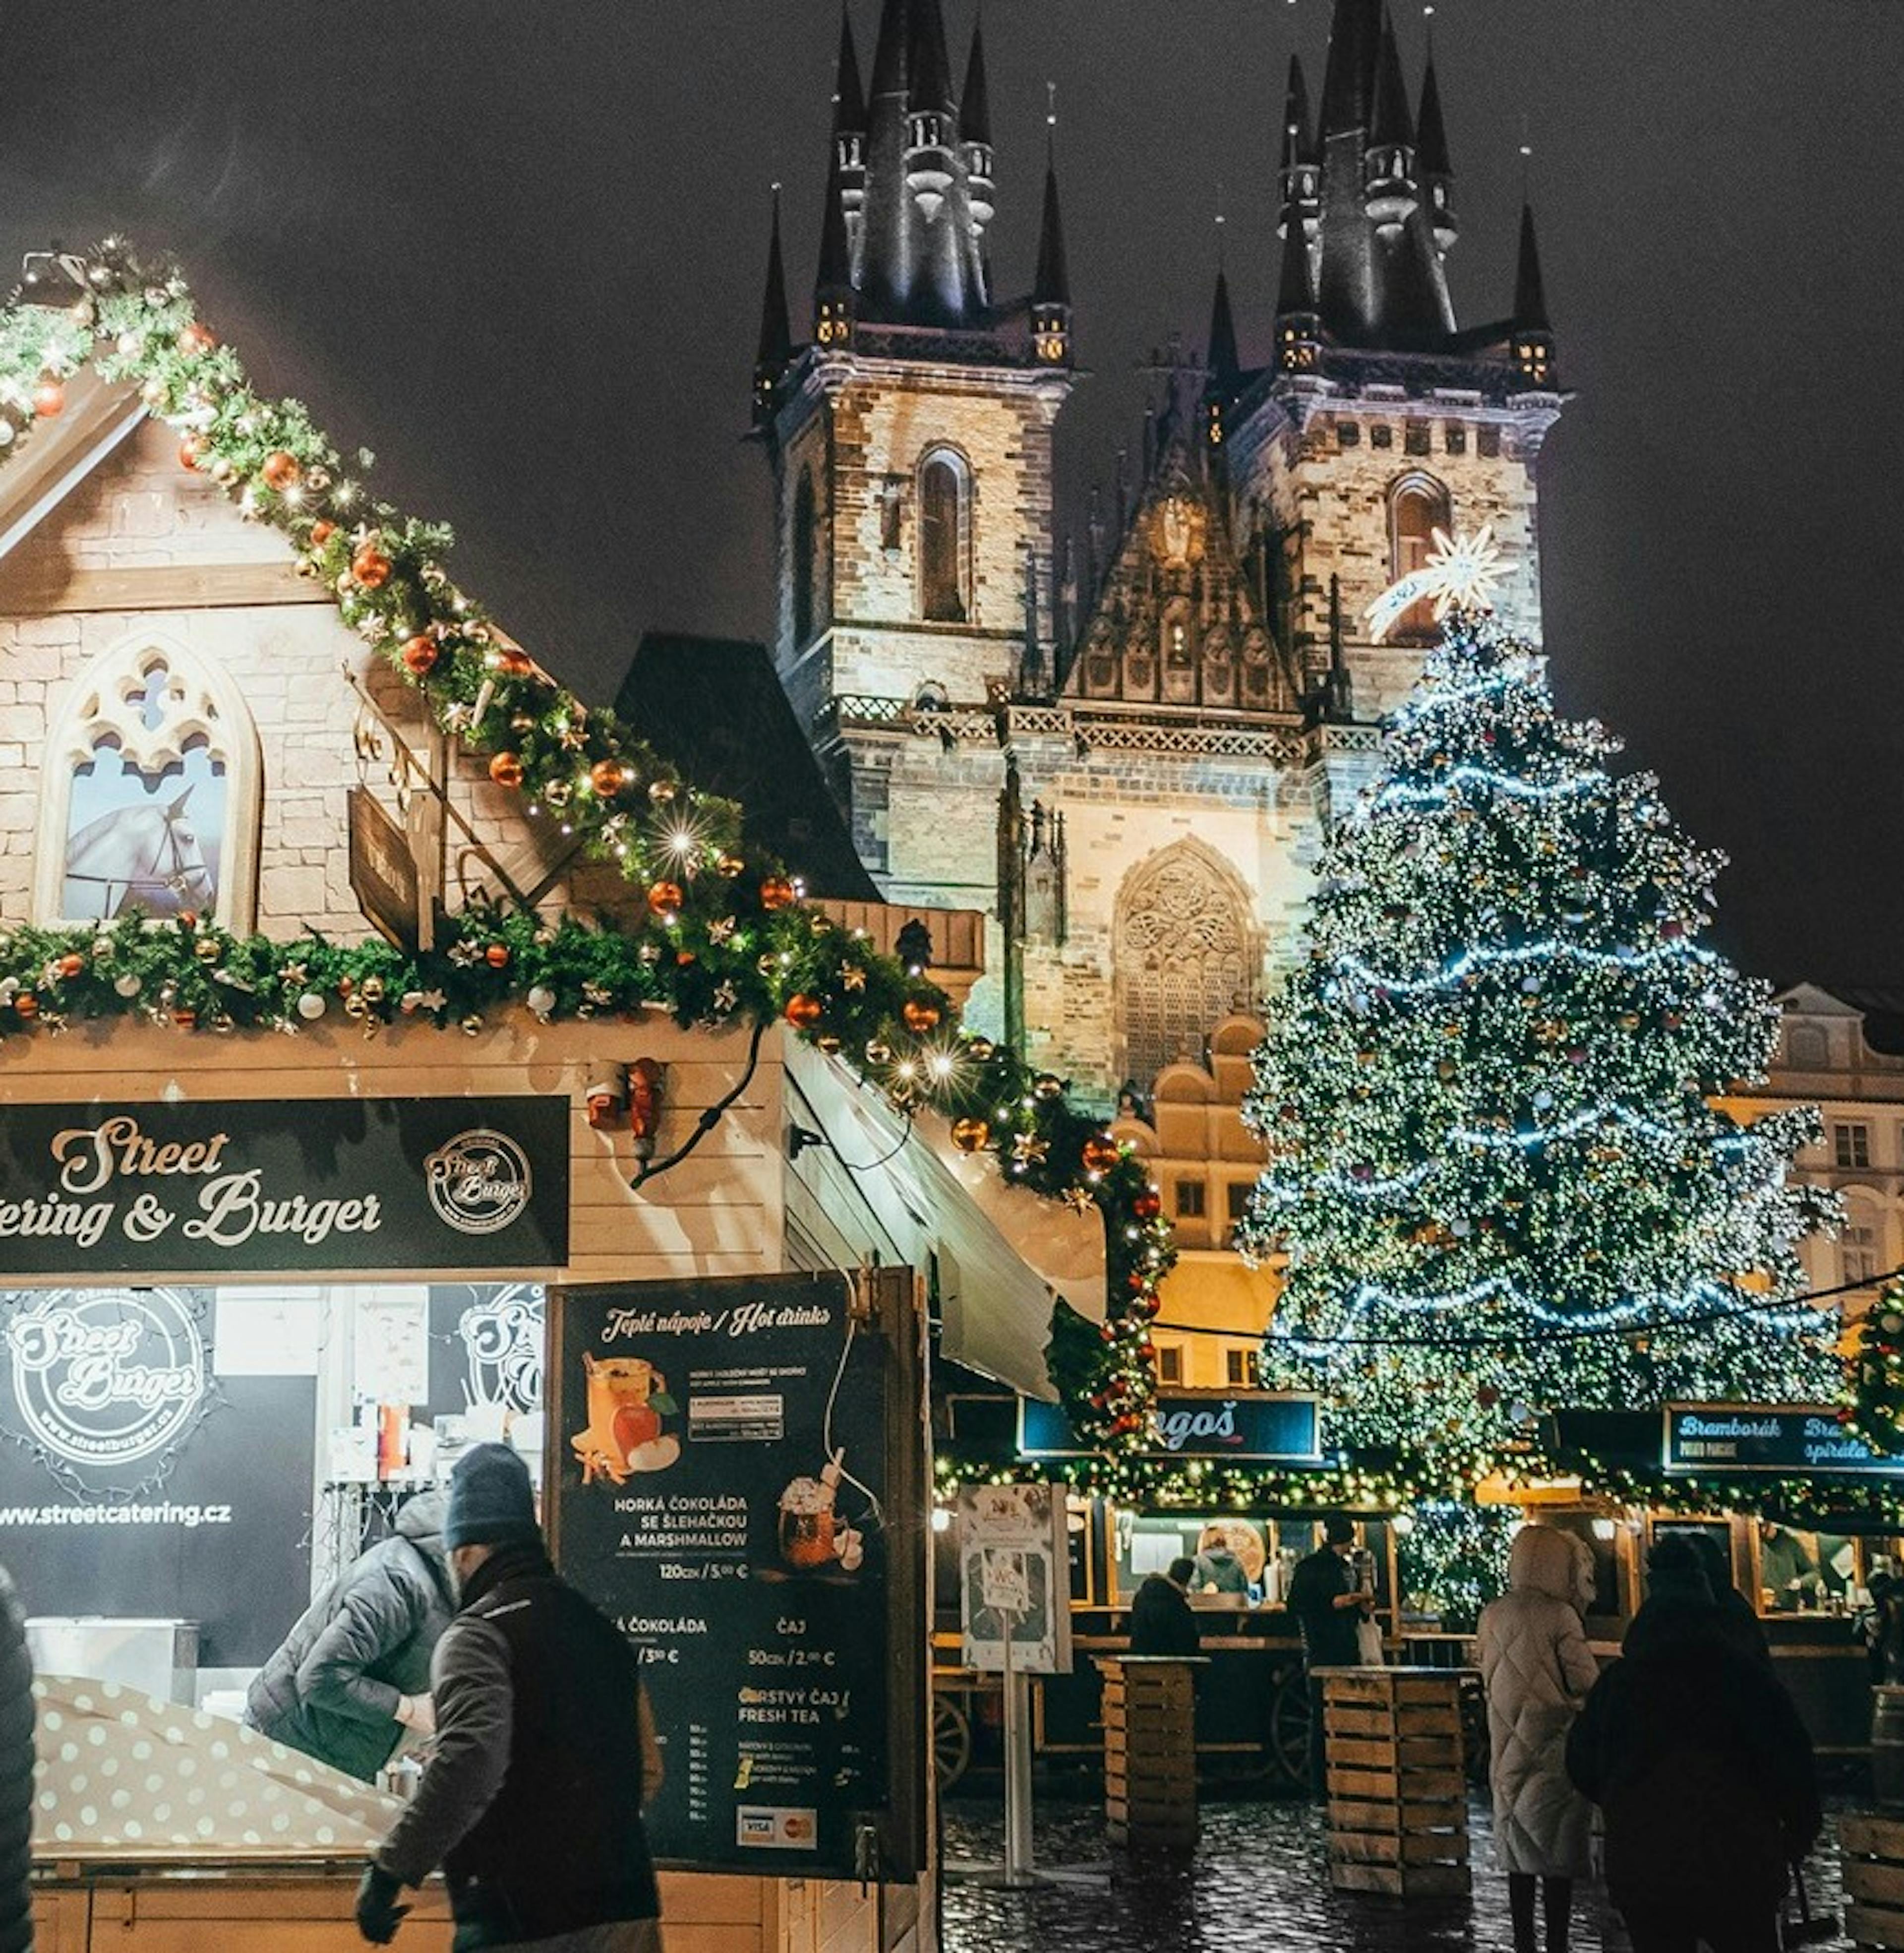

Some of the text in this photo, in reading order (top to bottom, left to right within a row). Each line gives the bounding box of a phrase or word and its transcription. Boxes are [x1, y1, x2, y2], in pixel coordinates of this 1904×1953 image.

[51, 1116, 231, 1193] Street
[0, 1192, 116, 1248] ering
[123, 1194, 176, 1241] &
[182, 1169, 382, 1246] Burger
[601, 1308, 655, 1343] Teplé
[656, 1310, 712, 1336] nápoje
[728, 1302, 776, 1337] Hot
[775, 1305, 831, 1326] drinks
[13, 1312, 140, 1368] Street
[60, 1355, 197, 1407] Burger
[1678, 1415, 1783, 1438] Bramborák
[1805, 1440, 1868, 1464] spirála
[614, 1493, 748, 1512] HORKÁ ČOKOLÁDA
[641, 1512, 747, 1529] SE ŠLEHAČKOU
[620, 1532, 748, 1547] A MARSHMALLOW
[627, 1615, 708, 1634] ČOKOLÁDA
[776, 1616, 807, 1635] ČAJ
[809, 1688, 839, 1706] ČAJ
[738, 1708, 821, 1724] FRESH TEA
